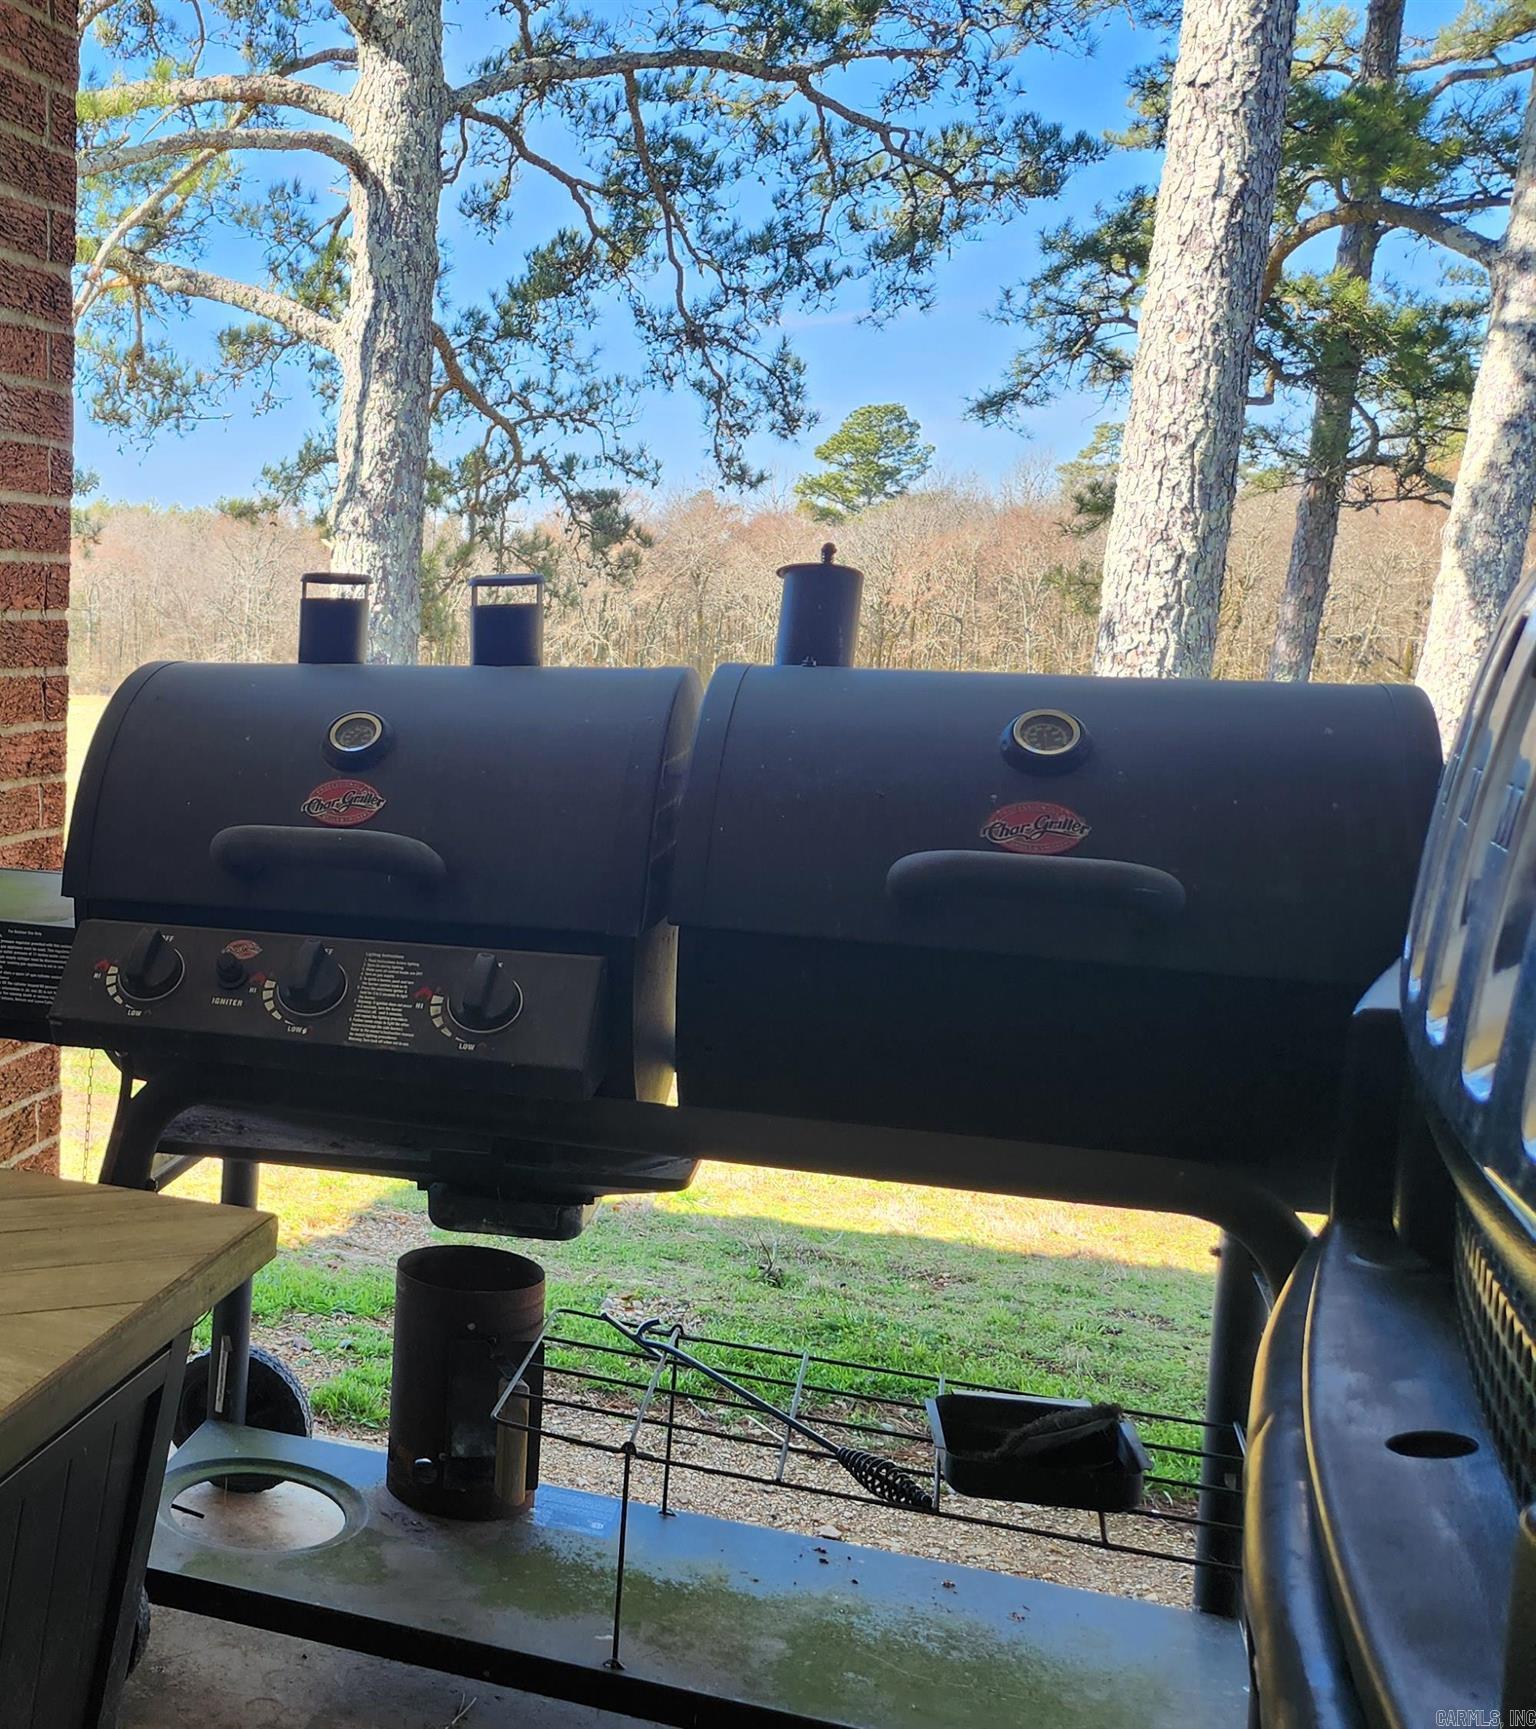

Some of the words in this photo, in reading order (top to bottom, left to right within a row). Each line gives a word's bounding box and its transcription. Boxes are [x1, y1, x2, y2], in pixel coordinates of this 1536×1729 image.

[211, 997, 244, 1007] IGNITER
[127, 1009, 143, 1017] LOW
[287, 1025, 302, 1034] LOW
[459, 1043, 475, 1051] LOW
